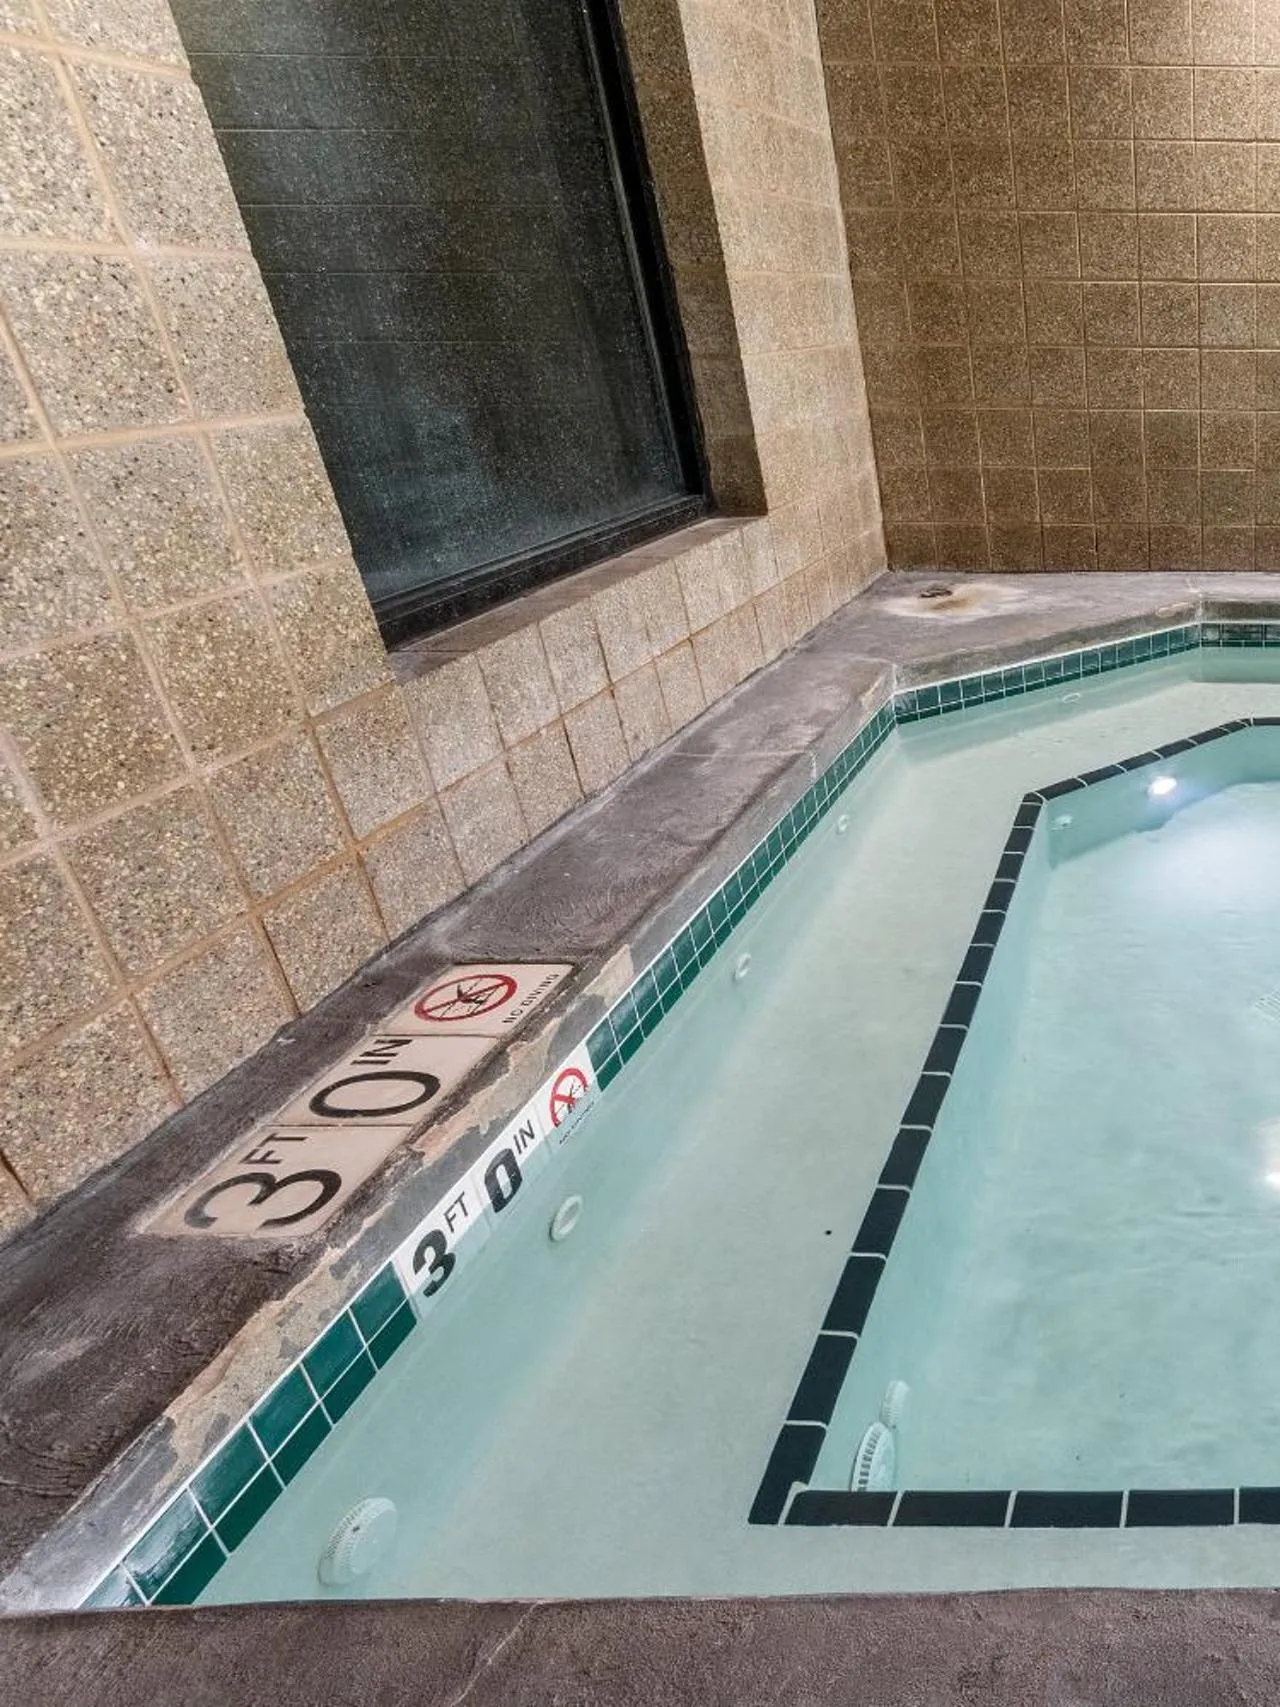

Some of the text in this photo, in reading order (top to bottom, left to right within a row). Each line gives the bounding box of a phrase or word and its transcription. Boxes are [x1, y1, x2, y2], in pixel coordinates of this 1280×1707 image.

[501, 974, 560, 1023] NO DIVING
[184, 1039, 441, 1229] 3 FT 0 IN
[412, 1119, 536, 1298] 3 FT 0 IN
